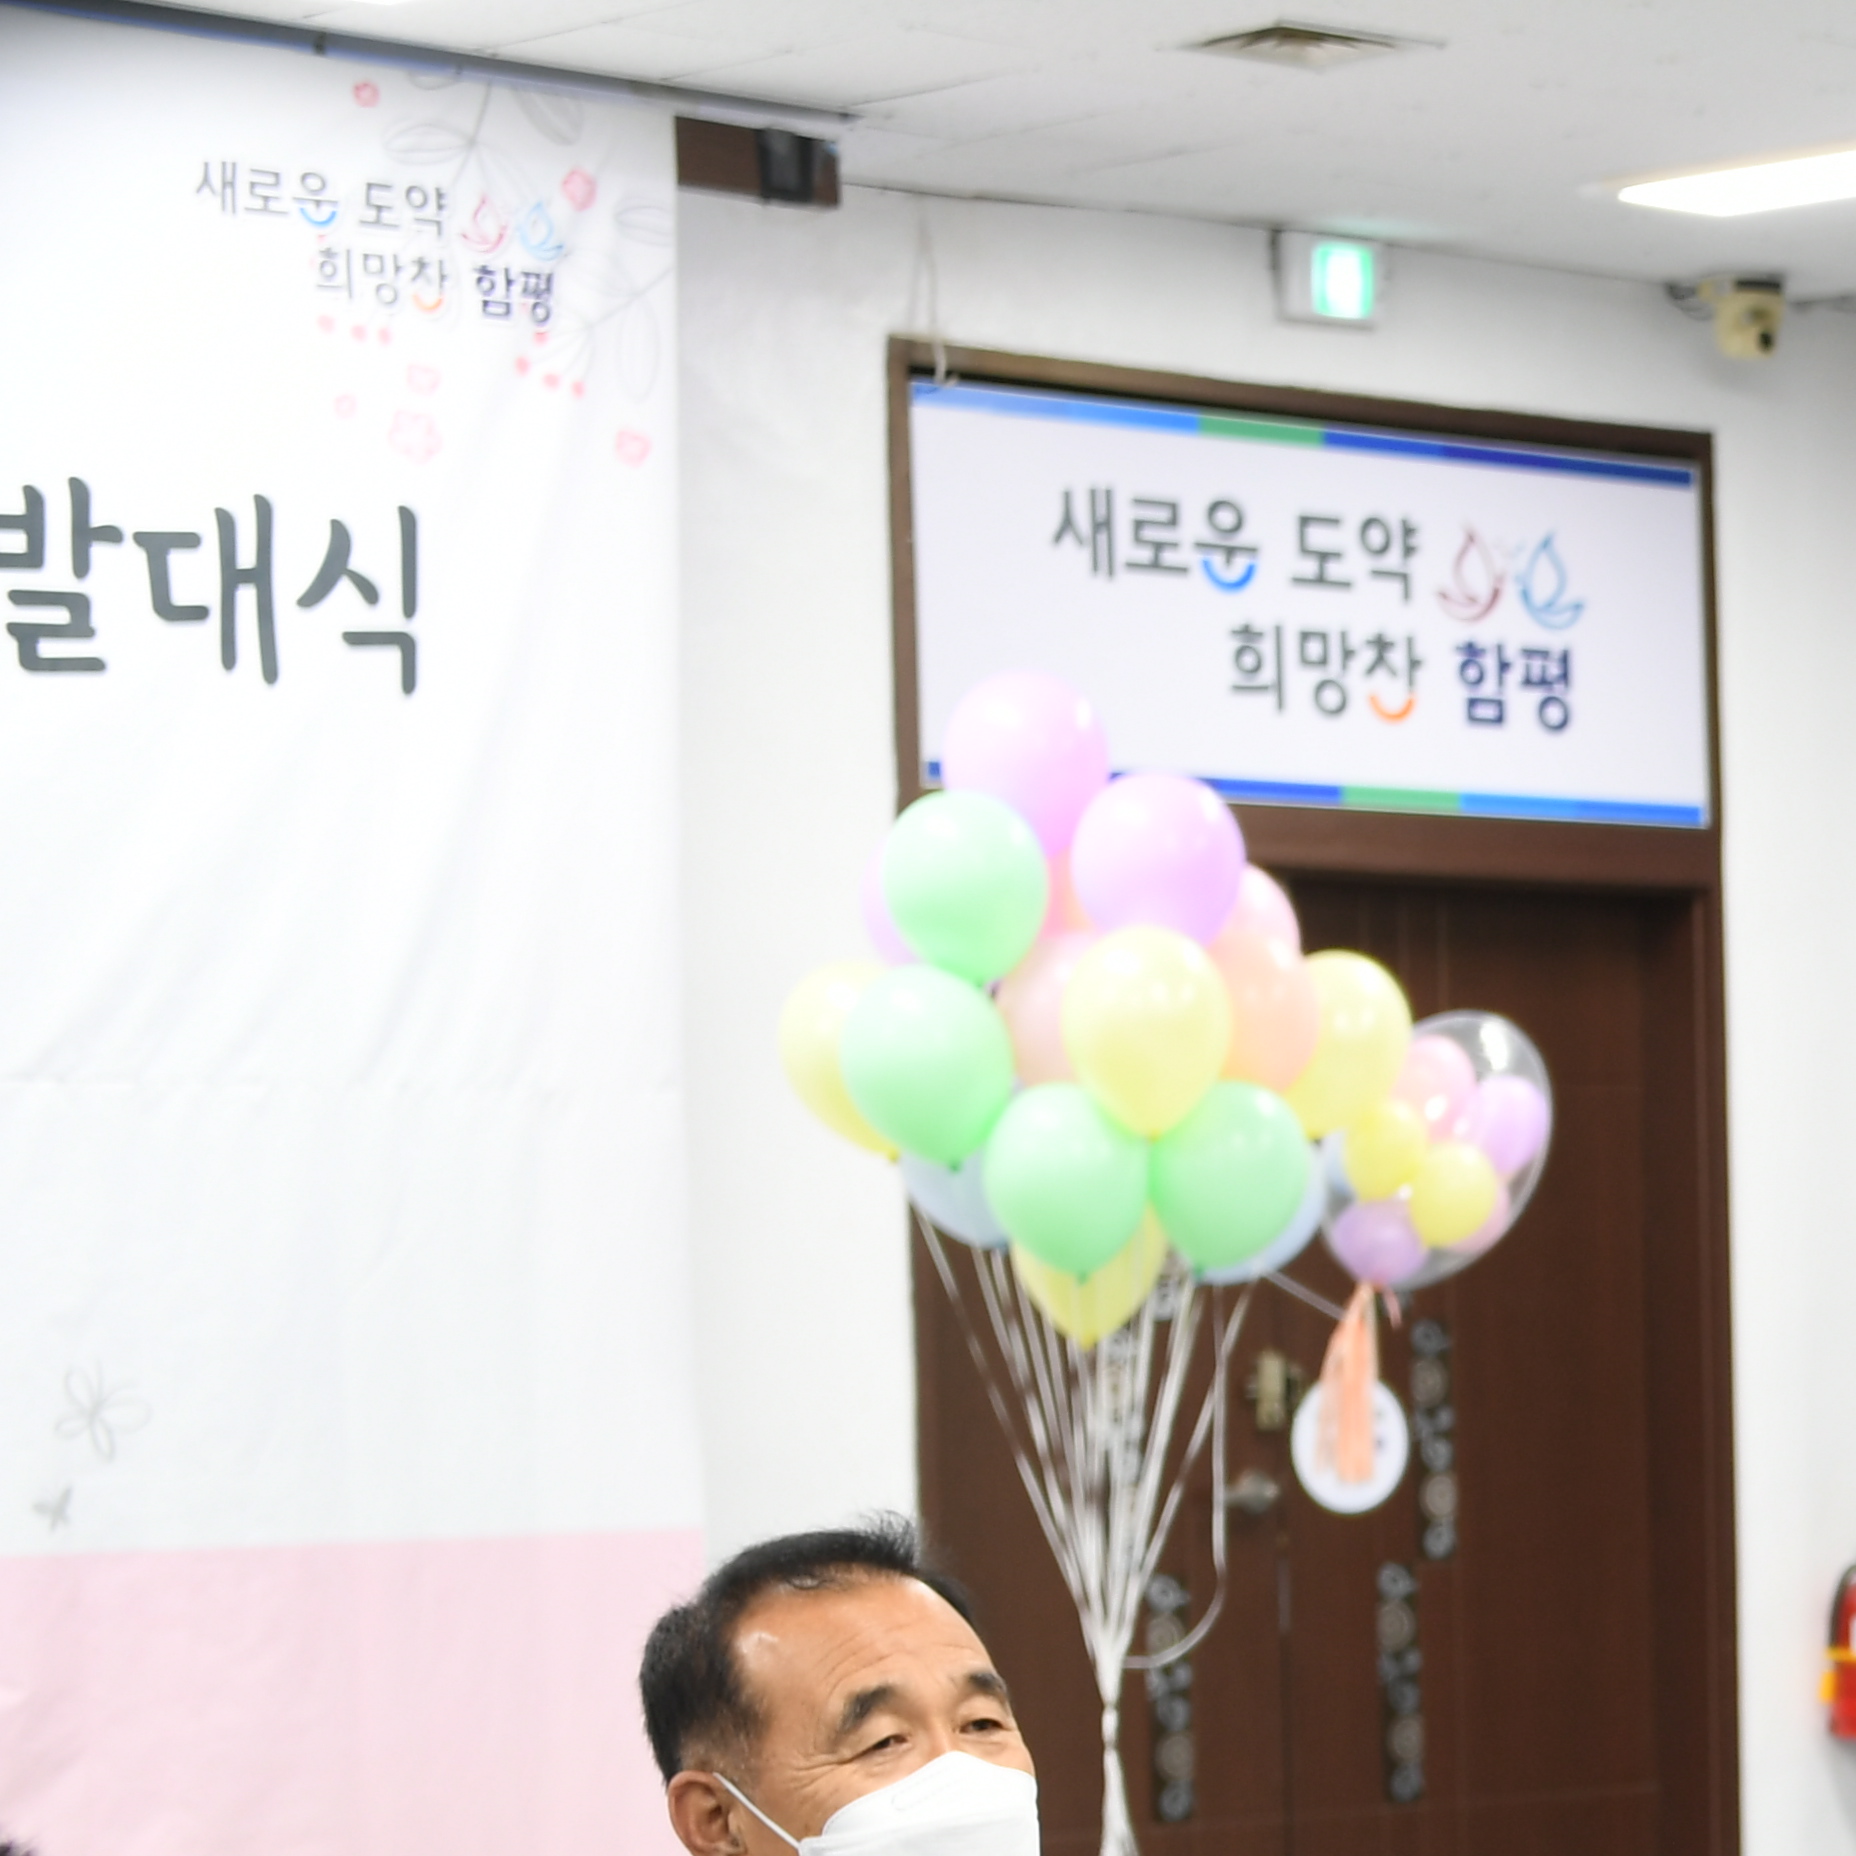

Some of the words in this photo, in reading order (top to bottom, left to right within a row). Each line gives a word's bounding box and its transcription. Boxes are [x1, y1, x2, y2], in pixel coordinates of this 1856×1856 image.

[197, 160, 338, 228] 새로운
[357, 181, 449, 236] 도약
[316, 245, 448, 312] 희망찬
[472, 262, 556, 327] 함평
[1052, 486, 1260, 593] 새로운
[1289, 513, 1420, 605] 도약
[1229, 622, 1424, 724] 희망찬
[1453, 638, 1573, 735] 함평
